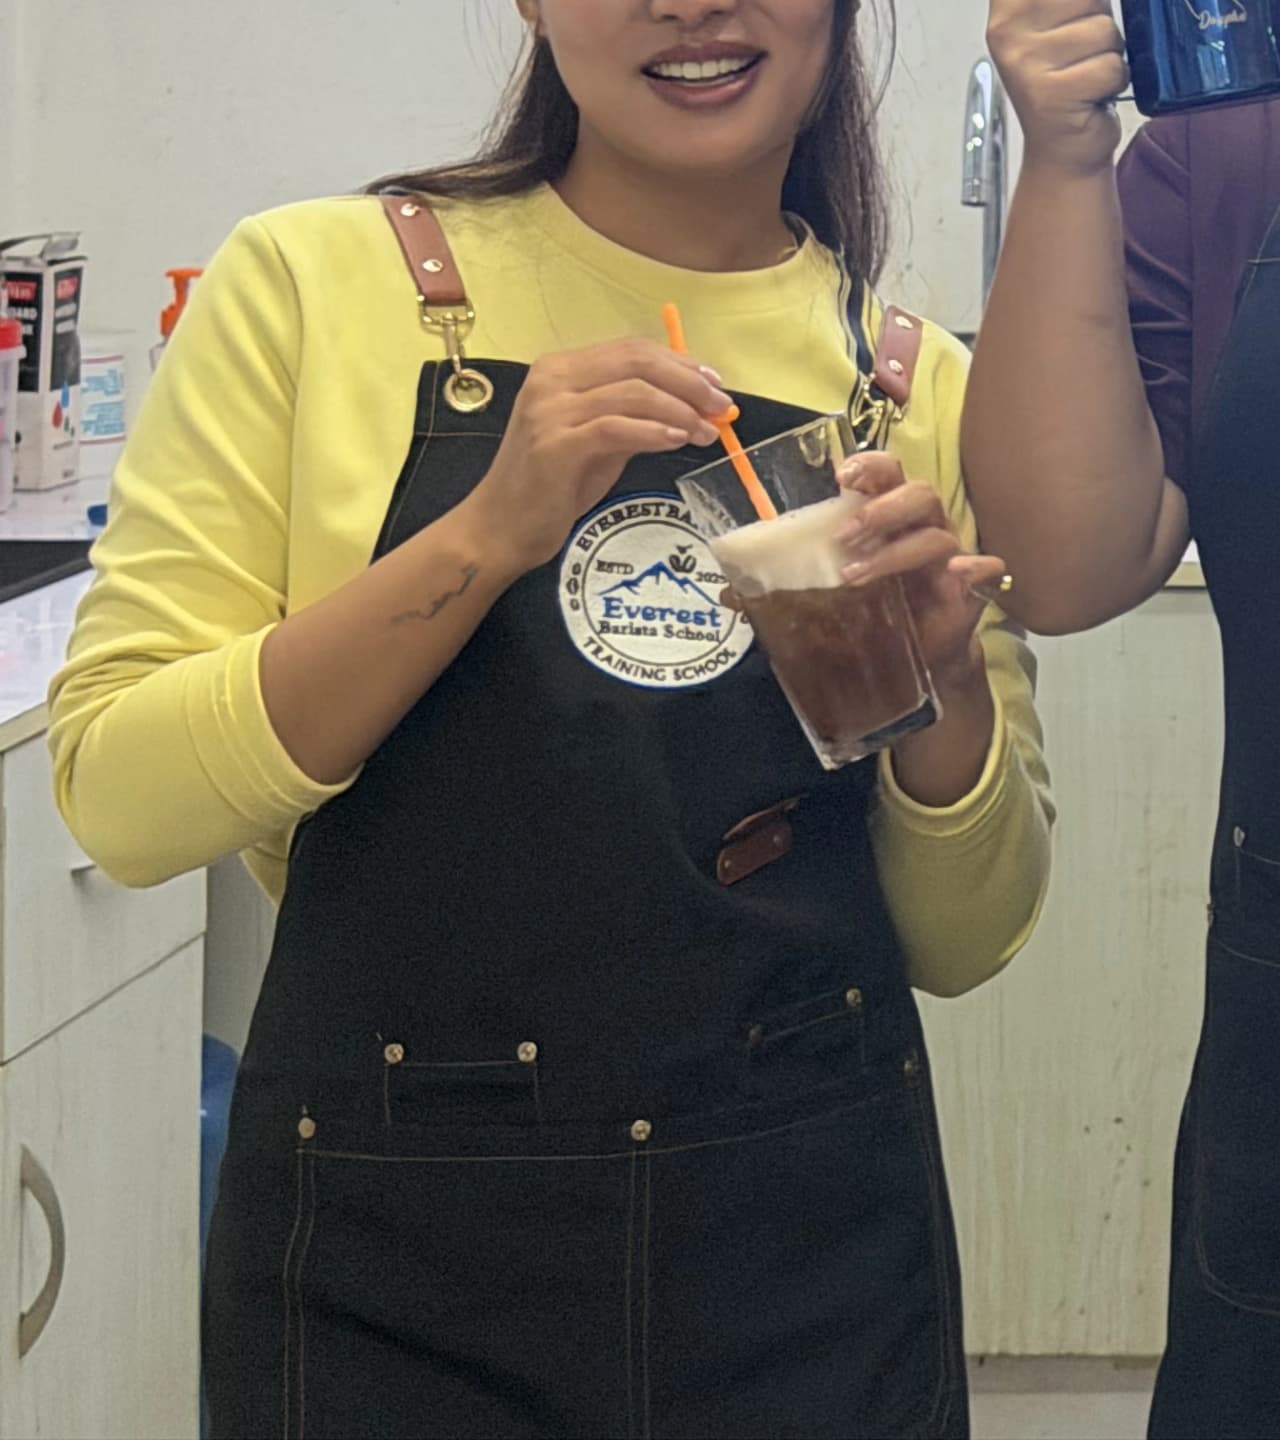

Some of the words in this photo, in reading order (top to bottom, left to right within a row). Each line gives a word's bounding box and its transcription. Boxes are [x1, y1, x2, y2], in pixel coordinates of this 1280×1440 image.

[576, 502, 666, 552] EVEREST
[602, 596, 722, 627] Everest
[599, 620, 657, 637] Barista
[664, 624, 722, 644] School
[583, 636, 666, 681] TRAINING
[672, 647, 737, 681] SCHOOL
